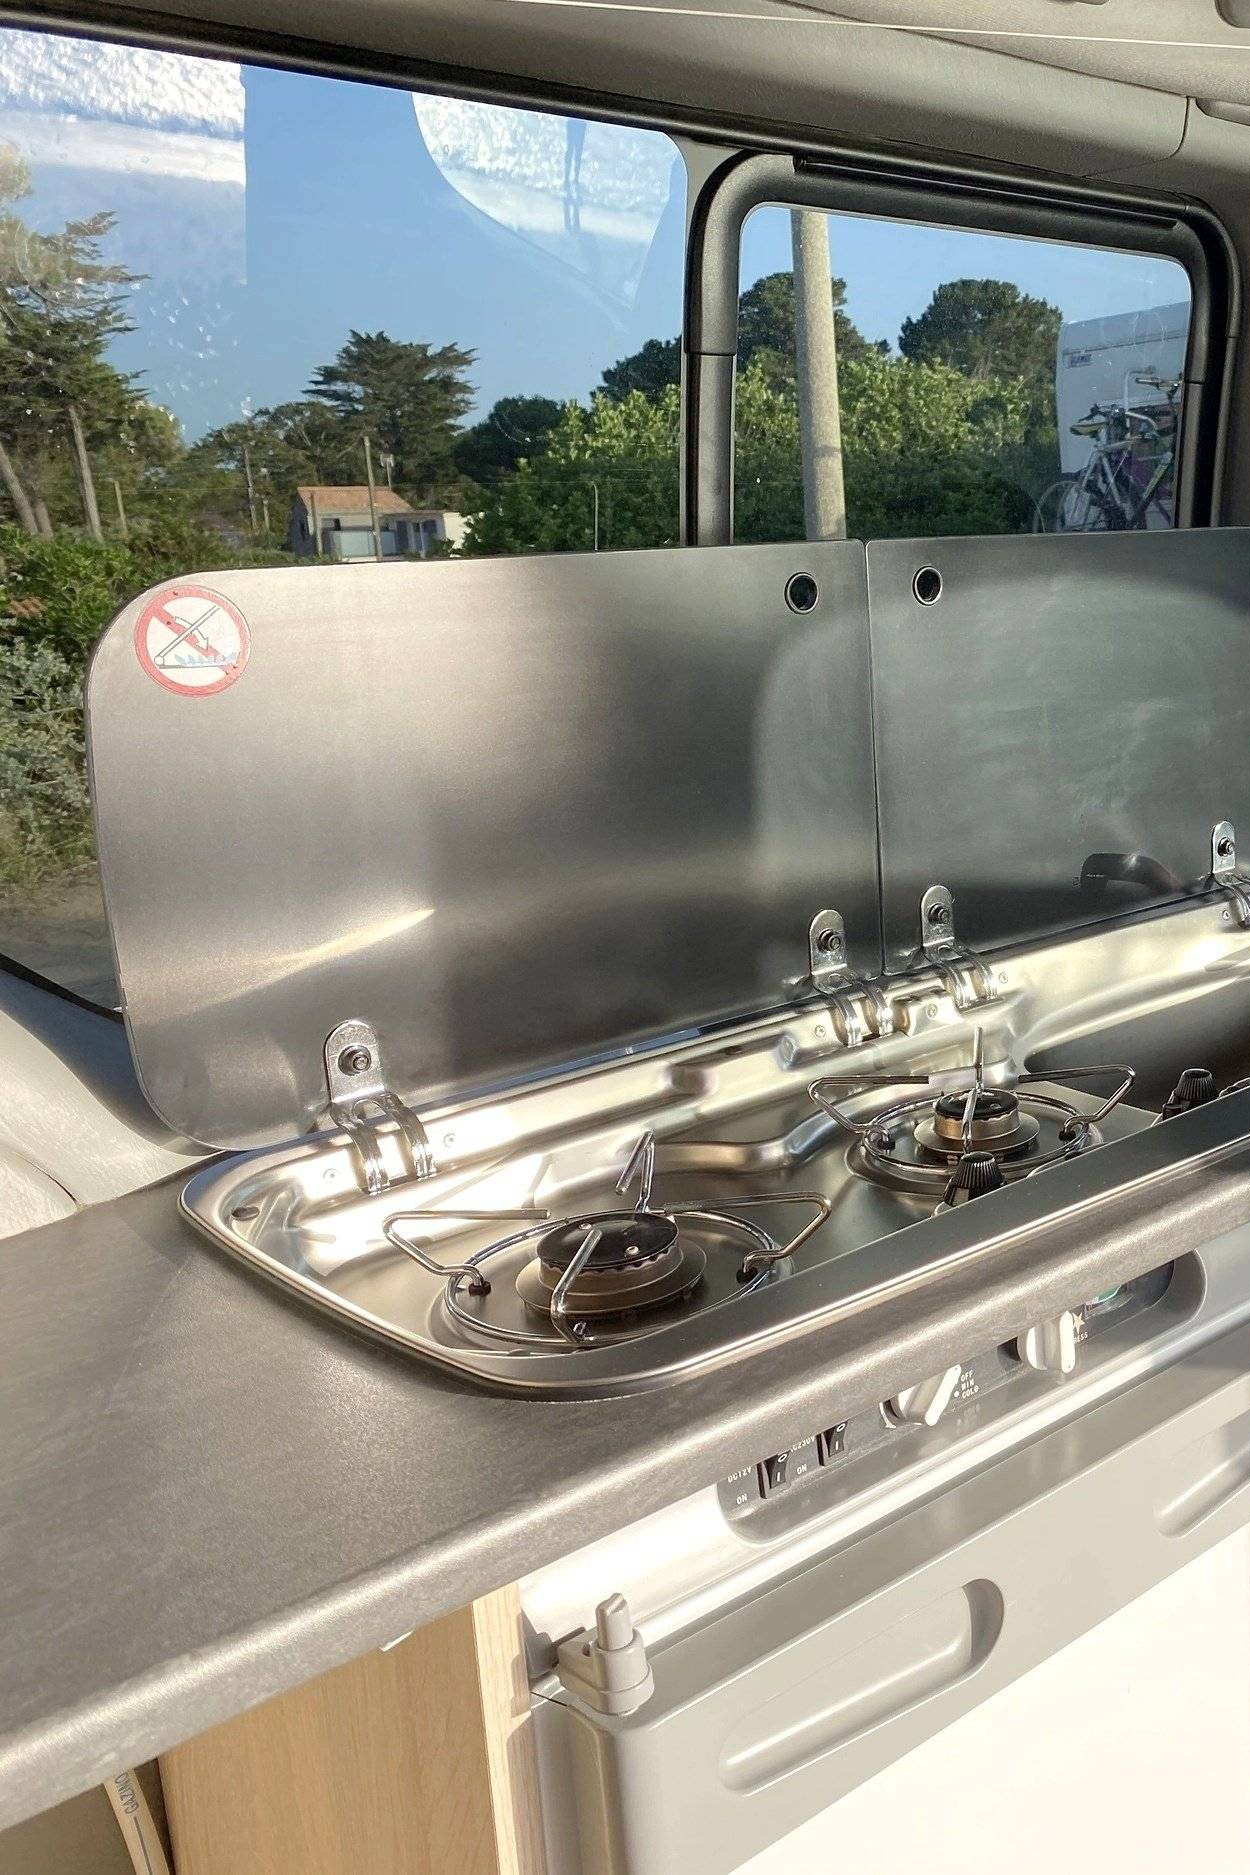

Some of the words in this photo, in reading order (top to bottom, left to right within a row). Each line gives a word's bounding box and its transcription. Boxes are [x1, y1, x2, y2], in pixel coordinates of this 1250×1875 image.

[960, 1369, 974, 1382] OFF
[796, 1463, 808, 1475] ON
[736, 1493, 748, 1505] ON
